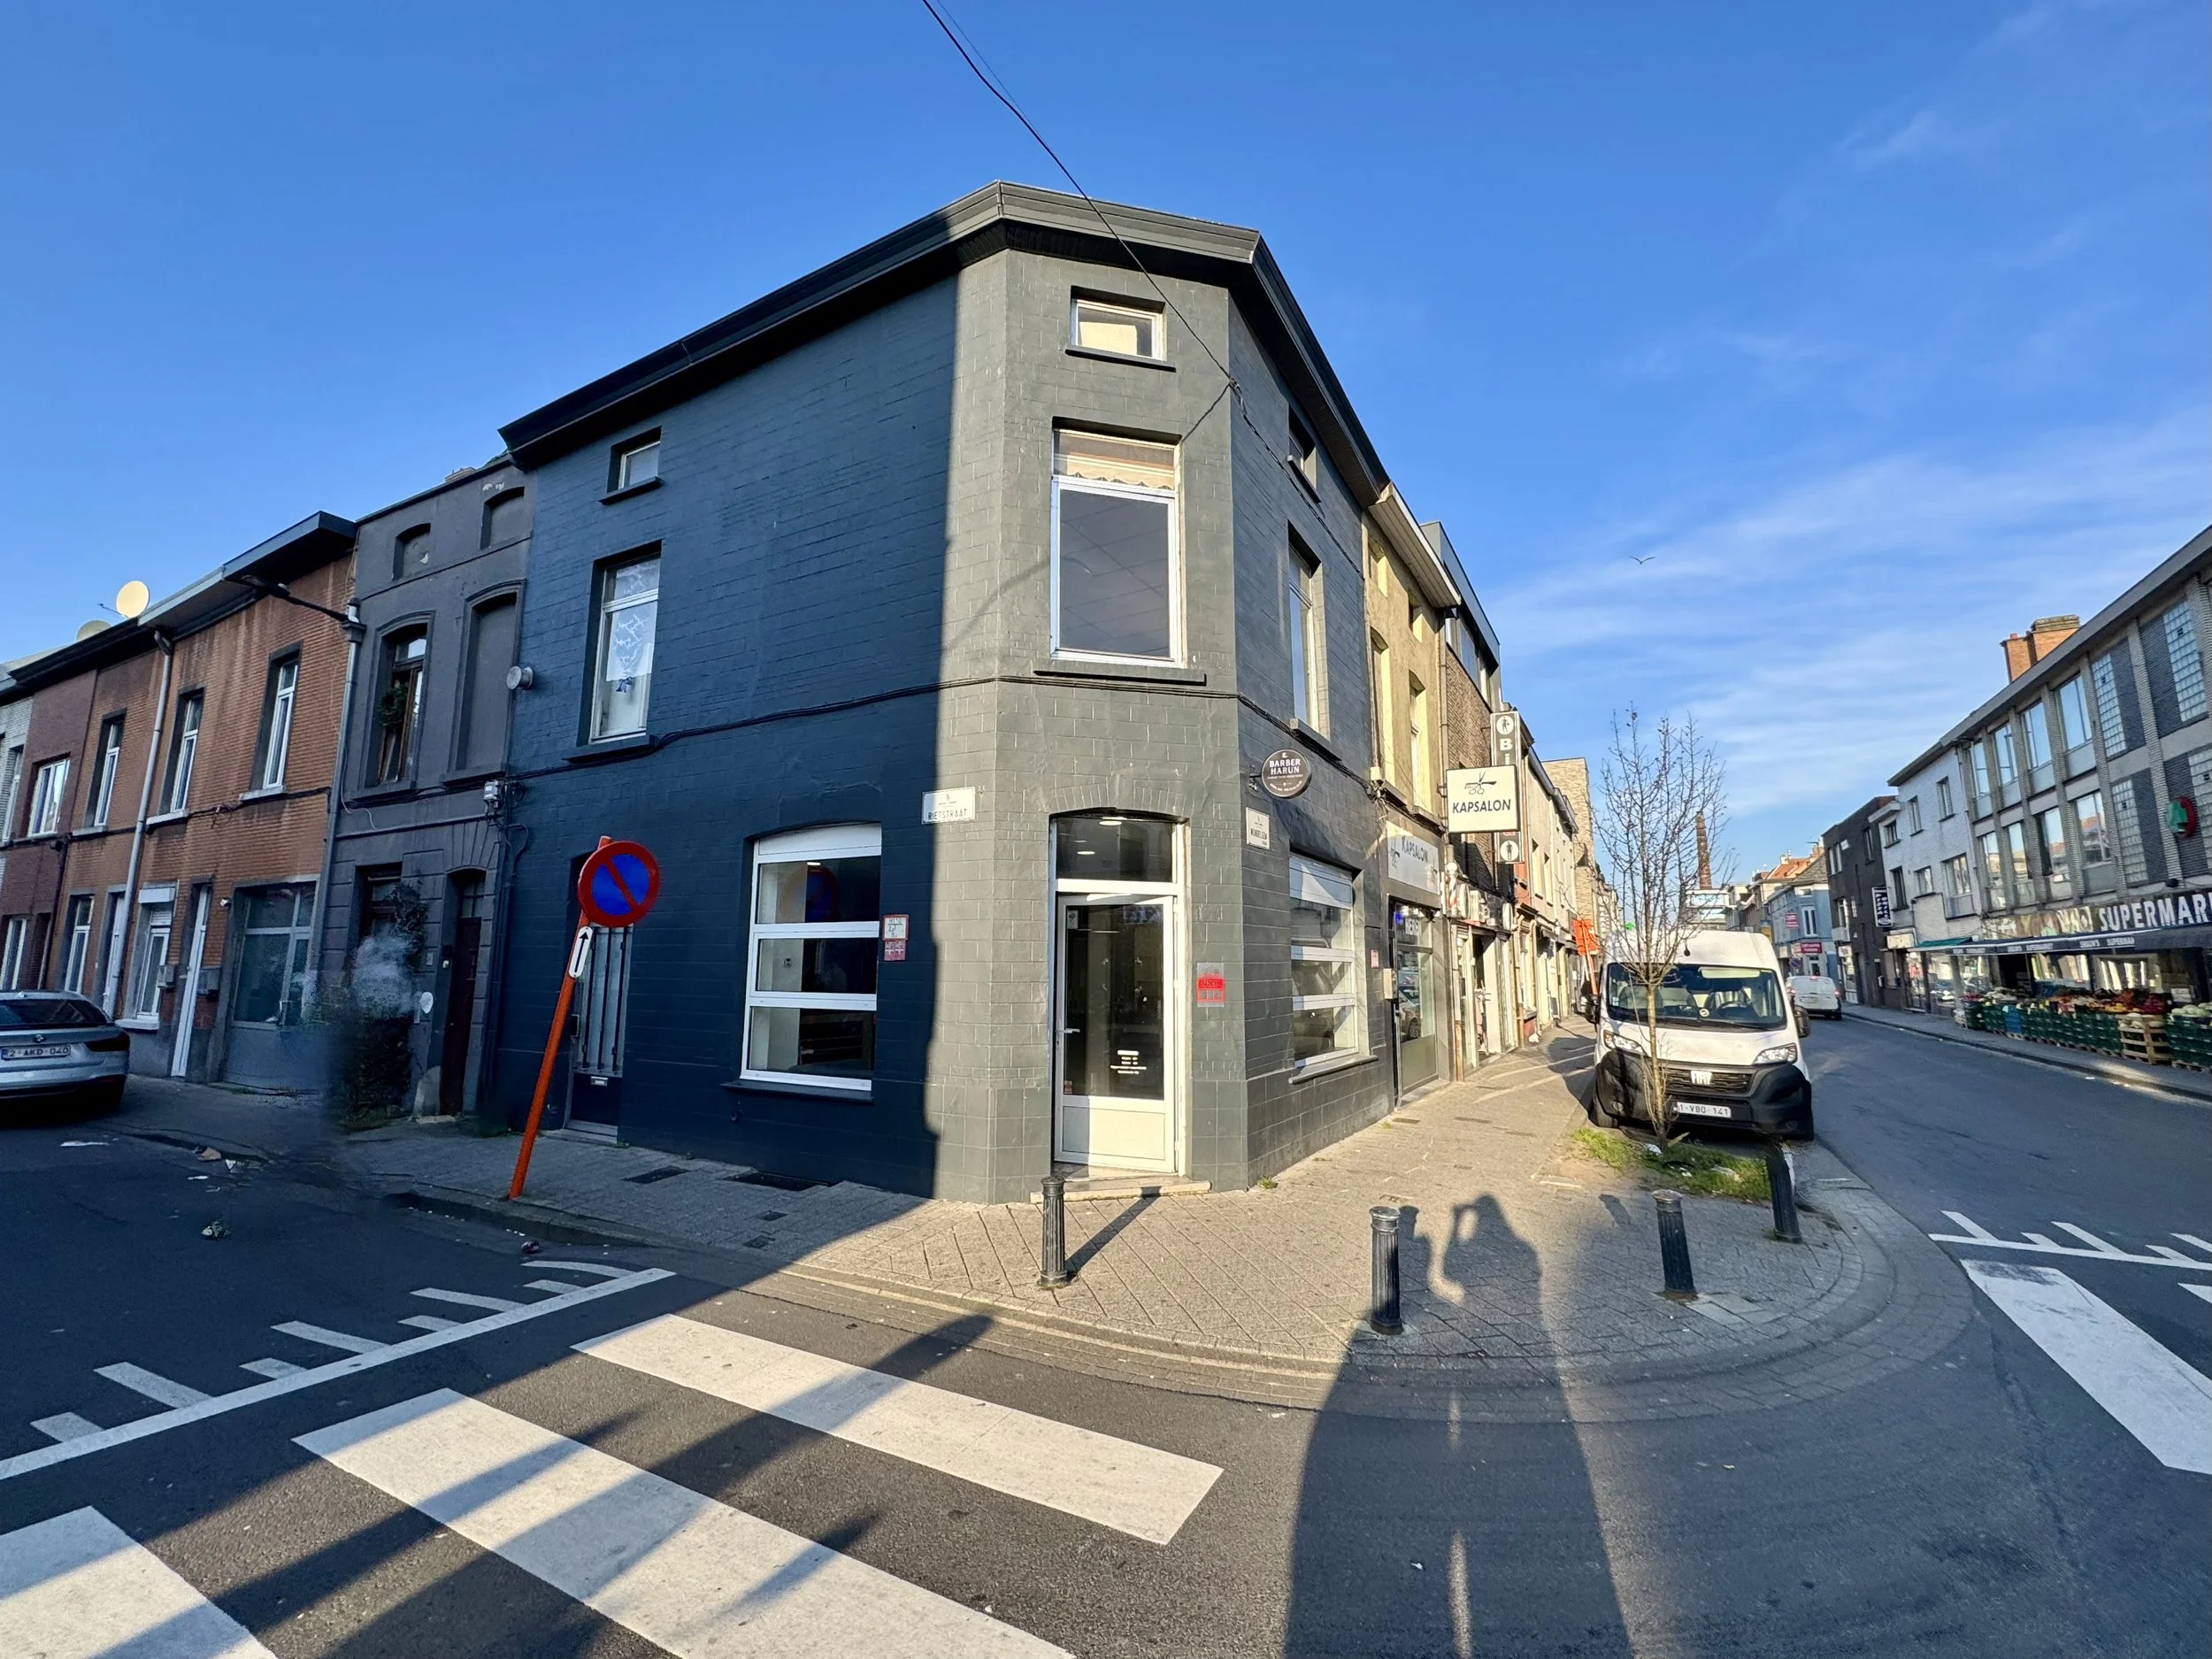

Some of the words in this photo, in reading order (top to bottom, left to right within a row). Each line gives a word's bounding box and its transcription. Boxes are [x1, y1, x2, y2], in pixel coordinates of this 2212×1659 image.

[1270, 758, 1301, 767] BARBER
[1271, 766, 1300, 775] HARUN
[1452, 799, 1511, 813] KAPSALON
[928, 809, 967, 820] RIETSTRAAT
[1402, 835, 1428, 863] KAPSALON
[1691, 1070, 1712, 1085] FIAT
